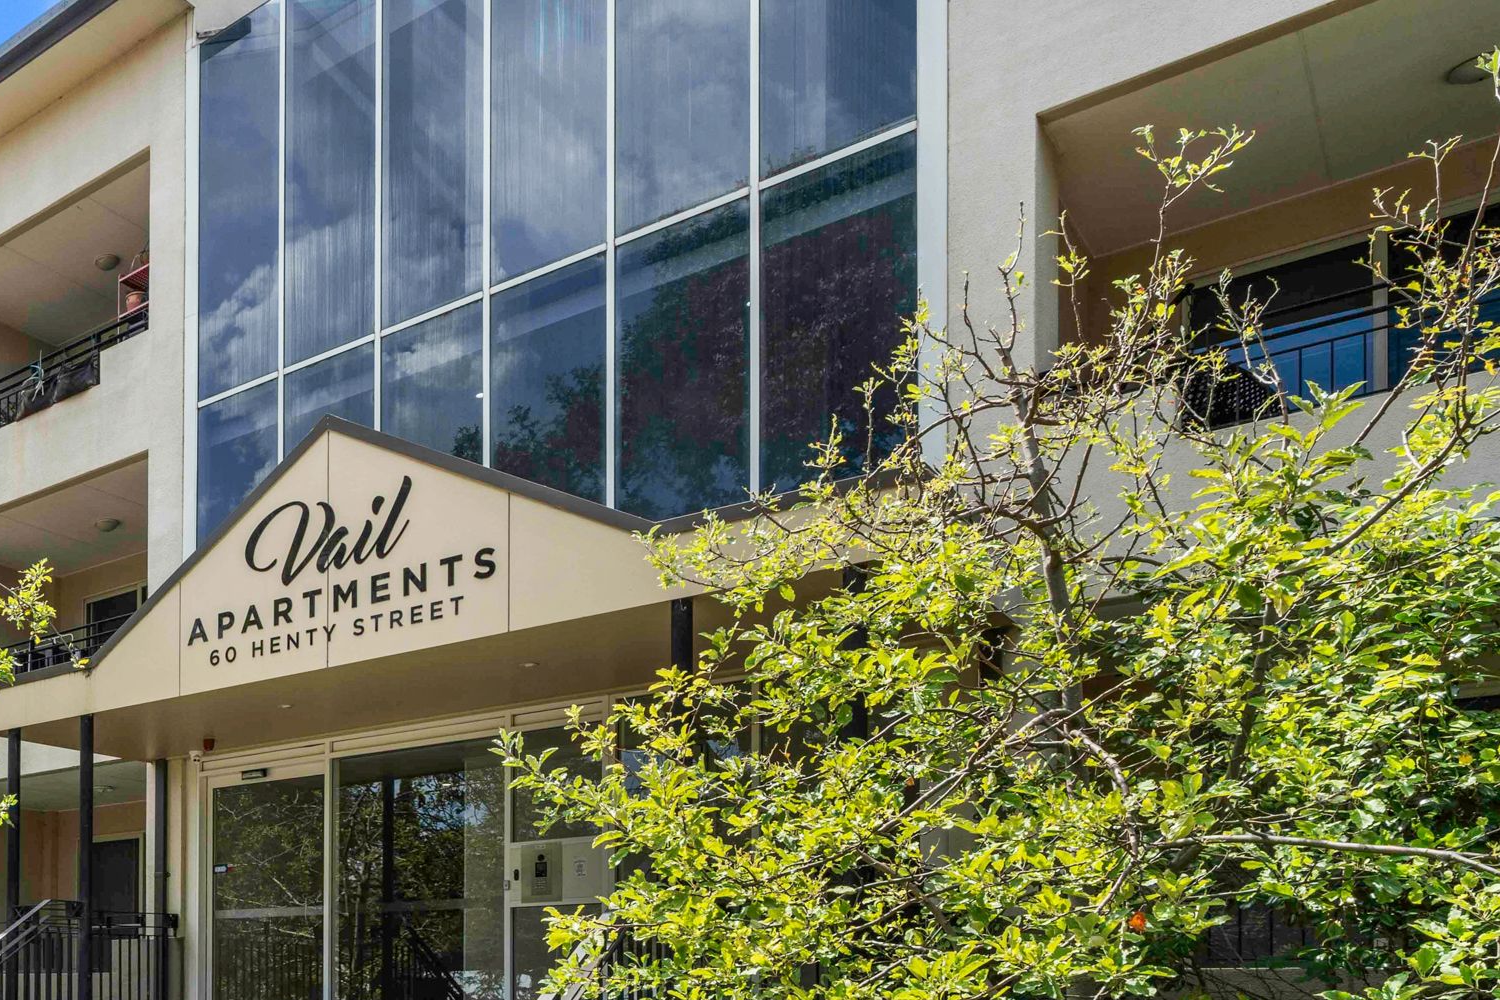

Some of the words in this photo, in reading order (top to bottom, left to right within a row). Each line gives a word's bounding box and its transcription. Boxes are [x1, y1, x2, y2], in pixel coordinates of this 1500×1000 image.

[245, 475, 412, 586] Vail
[187, 547, 497, 646] APARTMENTS
[209, 646, 237, 666] 60
[252, 623, 336, 658] HENTY
[353, 596, 464, 636] STREET
